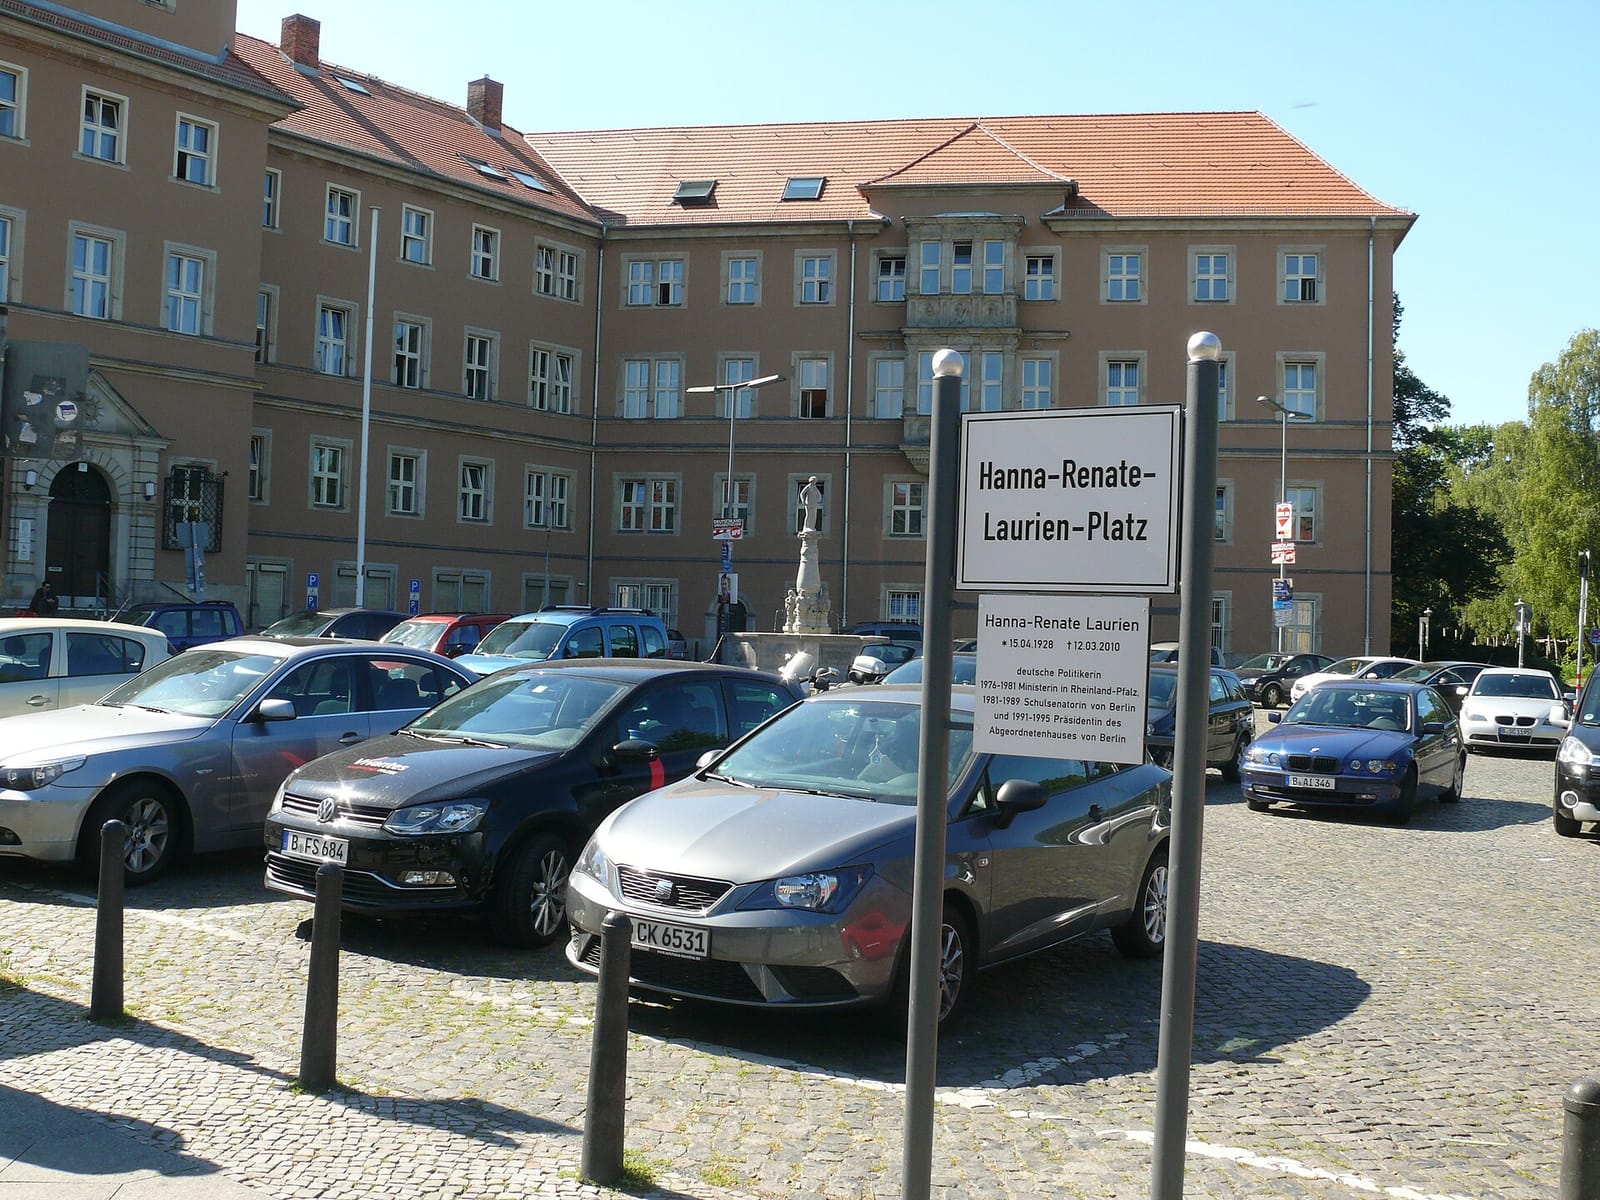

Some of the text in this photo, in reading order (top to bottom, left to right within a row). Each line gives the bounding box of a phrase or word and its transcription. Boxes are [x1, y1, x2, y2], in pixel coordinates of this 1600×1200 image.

[979, 459, 1157, 490] Hanna-Renate-
[983, 511, 1148, 541] Laurien-Platz
[309, 575, 317, 586] P
[411, 581, 418, 591] P
[985, 614, 1140, 632] Hanna-Renate Laurien
[1016, 667, 1102, 679] deutsche Politikerin
[980, 680, 1017, 691] 1976-1981
[1018, 682, 1059, 694] Ministerin
[1060, 684, 1069, 694] in
[983, 695, 1136, 713] 1981-1989 Schulsenatorin von Berlin
[993, 712, 1122, 728] und 1991-1995 Präsidentin des
[988, 726, 1127, 744] Abgeordnetenhauses von Berlin
[1292, 776, 1298, 786] B
[1314, 778, 1330, 788] 346
[291, 834, 344, 860] B FS 684
[637, 922, 705, 953] CK 6531
